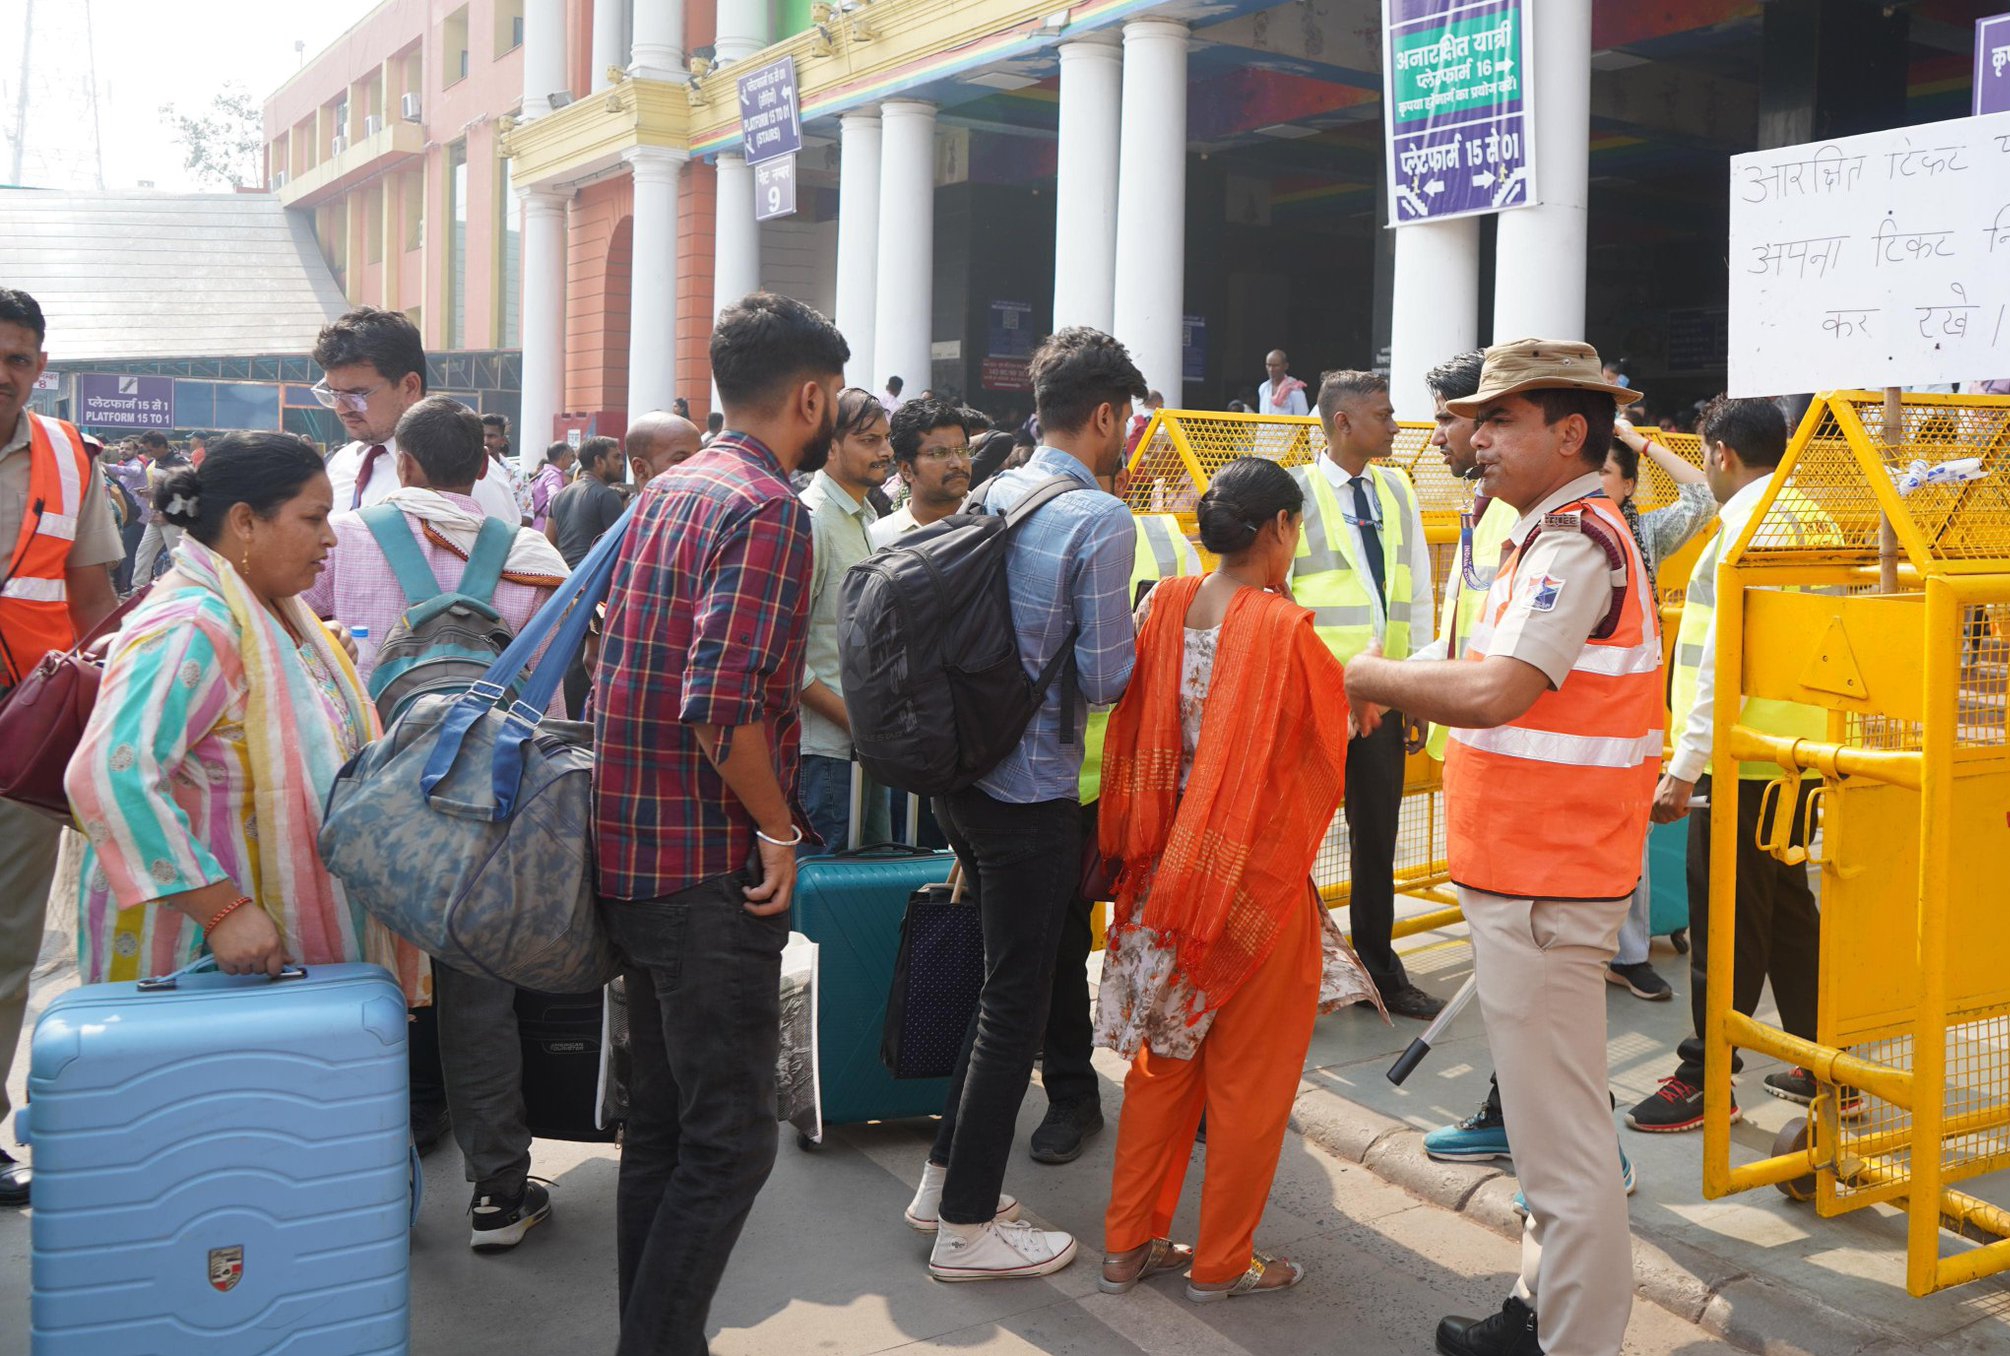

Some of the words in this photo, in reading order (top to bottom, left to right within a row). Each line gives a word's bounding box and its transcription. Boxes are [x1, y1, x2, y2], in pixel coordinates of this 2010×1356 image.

[1397, 33, 1470, 70] अनारक्षित
[1473, 20, 1512, 51] यात्री
[1477, 60, 1492, 77] 16
[744, 111, 769, 133] PLATFORM
[768, 109, 775, 124] 15
[775, 107, 782, 121] TO
[782, 104, 790, 120] 01
[1399, 99, 1423, 117] कृपया
[756, 126, 781, 148] (STAIRS)
[1400, 133, 1462, 176] प्लेटफार्म
[1466, 139, 1483, 167] 15
[1485, 128, 1500, 163] से
[1502, 133, 1519, 160] 01
[1742, 145, 1867, 203] आरक्षित
[768, 186, 780, 213] 9
[1747, 235, 1851, 279] अपना
[1822, 309, 1881, 339] कर
[39, 380, 46, 389] 8
[88, 396, 138, 409] प्लेटफार्म
[138, 401, 149, 410] 15
[152, 399, 161, 411] से
[164, 402, 168, 411] 1
[86, 411, 135, 423] PLATFORM
[138, 414, 148, 423] 15
[151, 414, 162, 424] TO
[165, 414, 169, 424] 1
